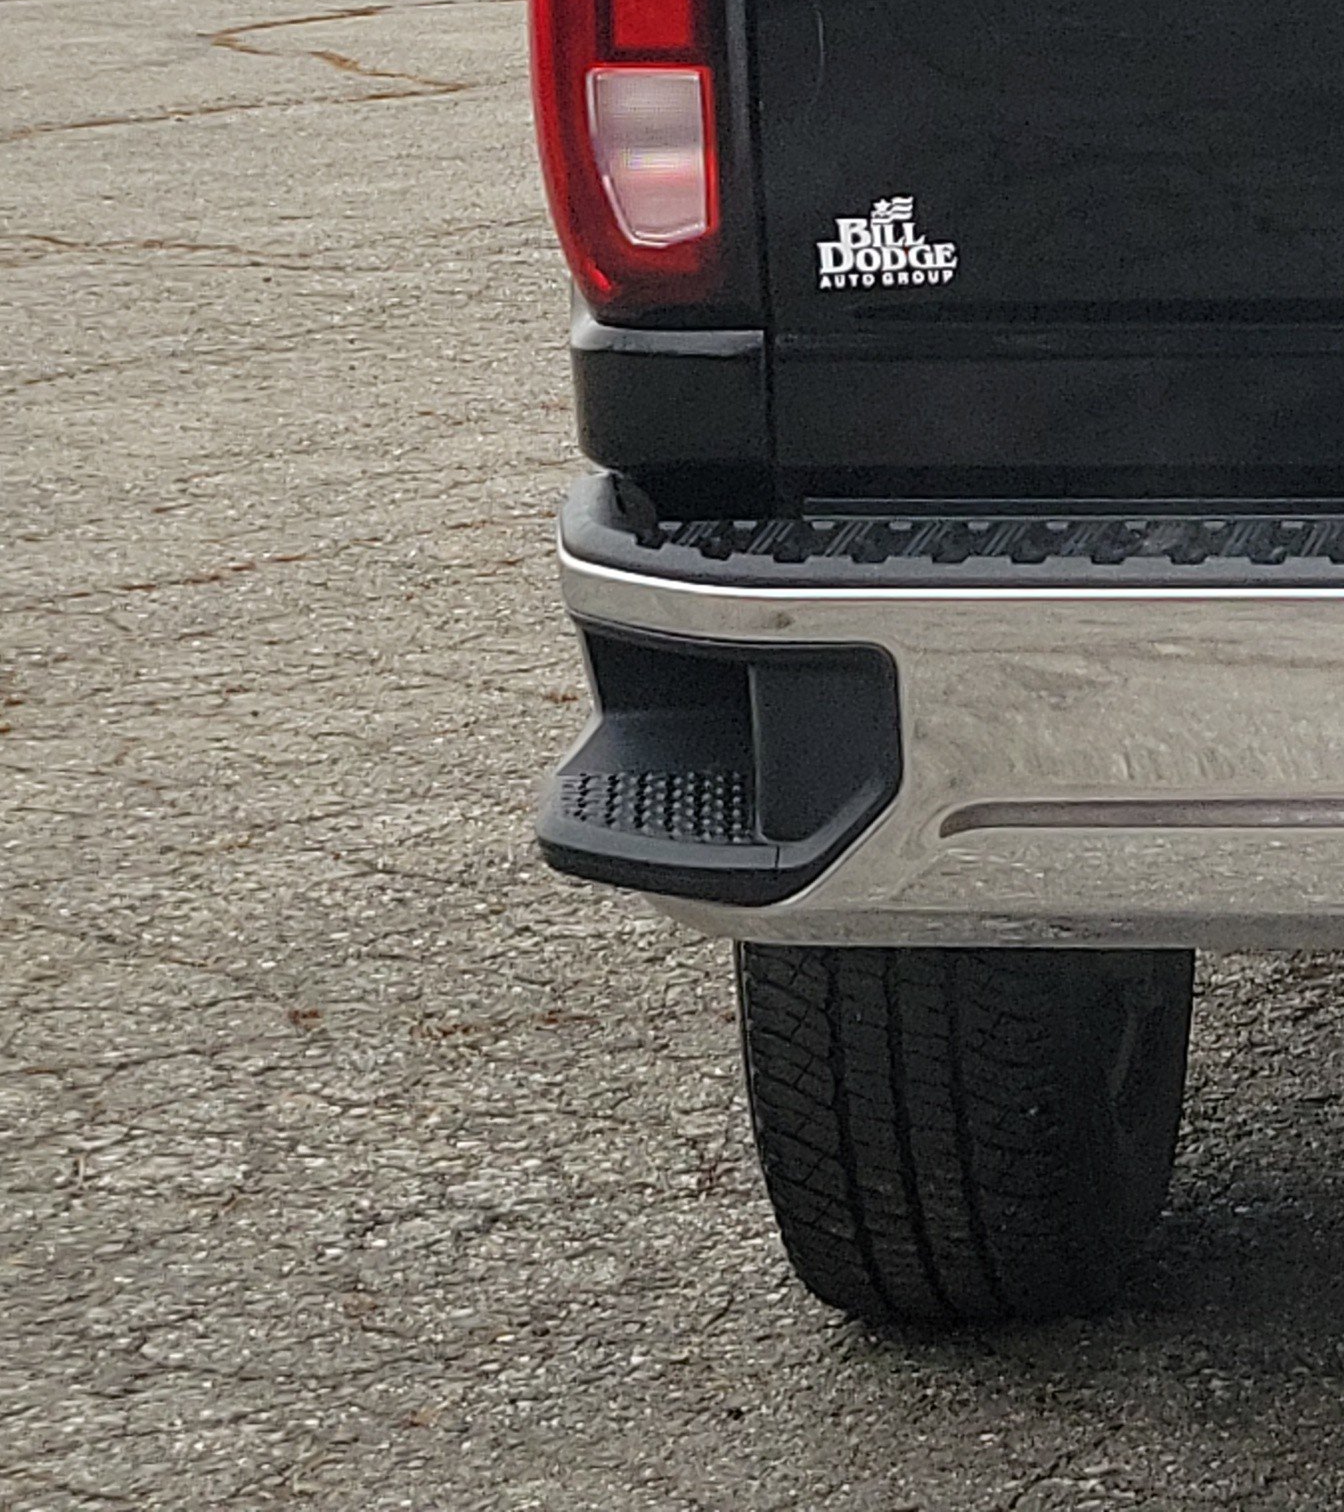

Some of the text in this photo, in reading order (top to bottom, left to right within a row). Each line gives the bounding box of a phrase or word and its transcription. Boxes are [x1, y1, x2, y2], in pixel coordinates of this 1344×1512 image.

[834, 218, 926, 250] BILL
[816, 242, 959, 275] DODGE
[819, 269, 954, 289] AUTO GROUP
